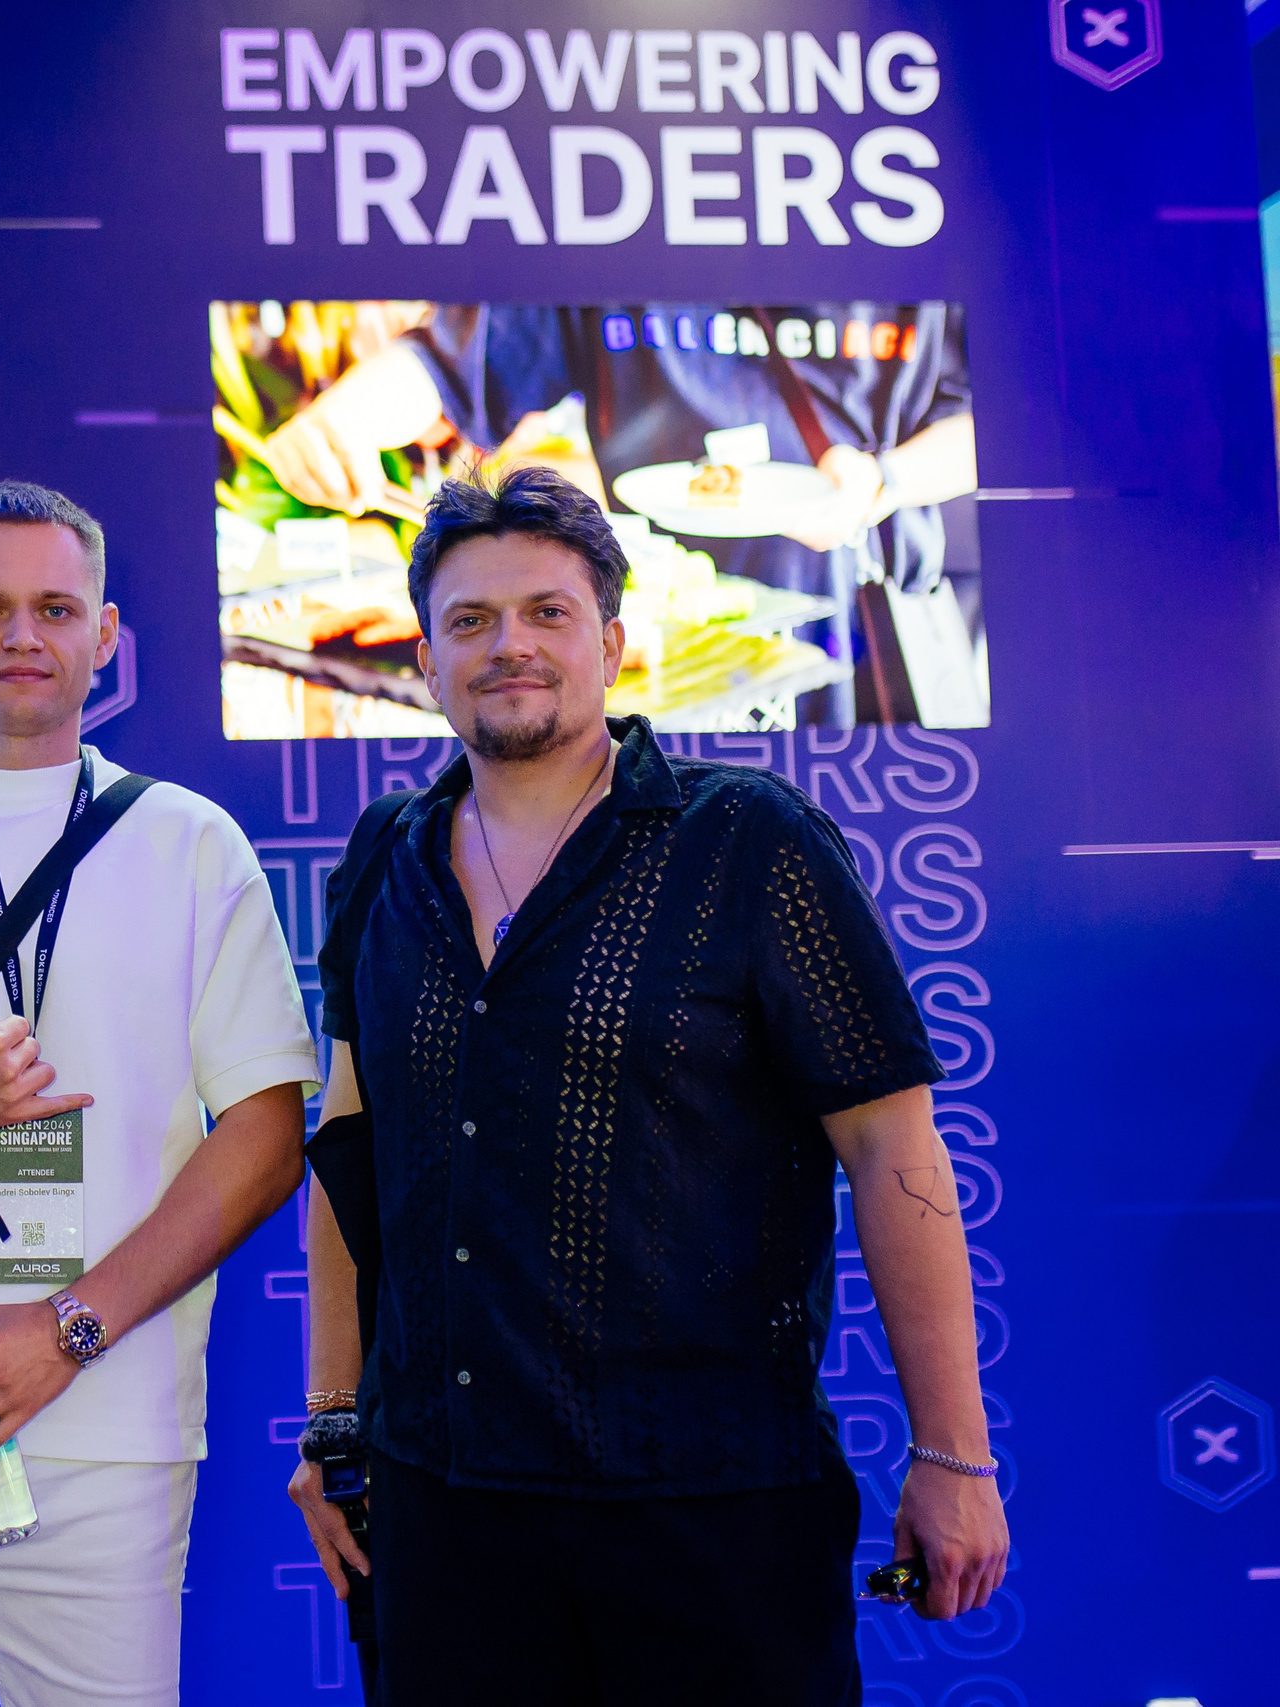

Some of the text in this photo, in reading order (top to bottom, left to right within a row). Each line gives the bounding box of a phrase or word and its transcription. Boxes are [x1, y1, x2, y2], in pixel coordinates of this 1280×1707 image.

[220, 28, 941, 116] EMPOWERING
[225, 125, 945, 247] TRADERS
[0, 1131, 73, 1146] SINGAPORE
[17, 1168, 55, 1177] ATTENDEE
[52, 1187, 75, 1198] Bingx
[12, 1263, 61, 1273] AUROS
